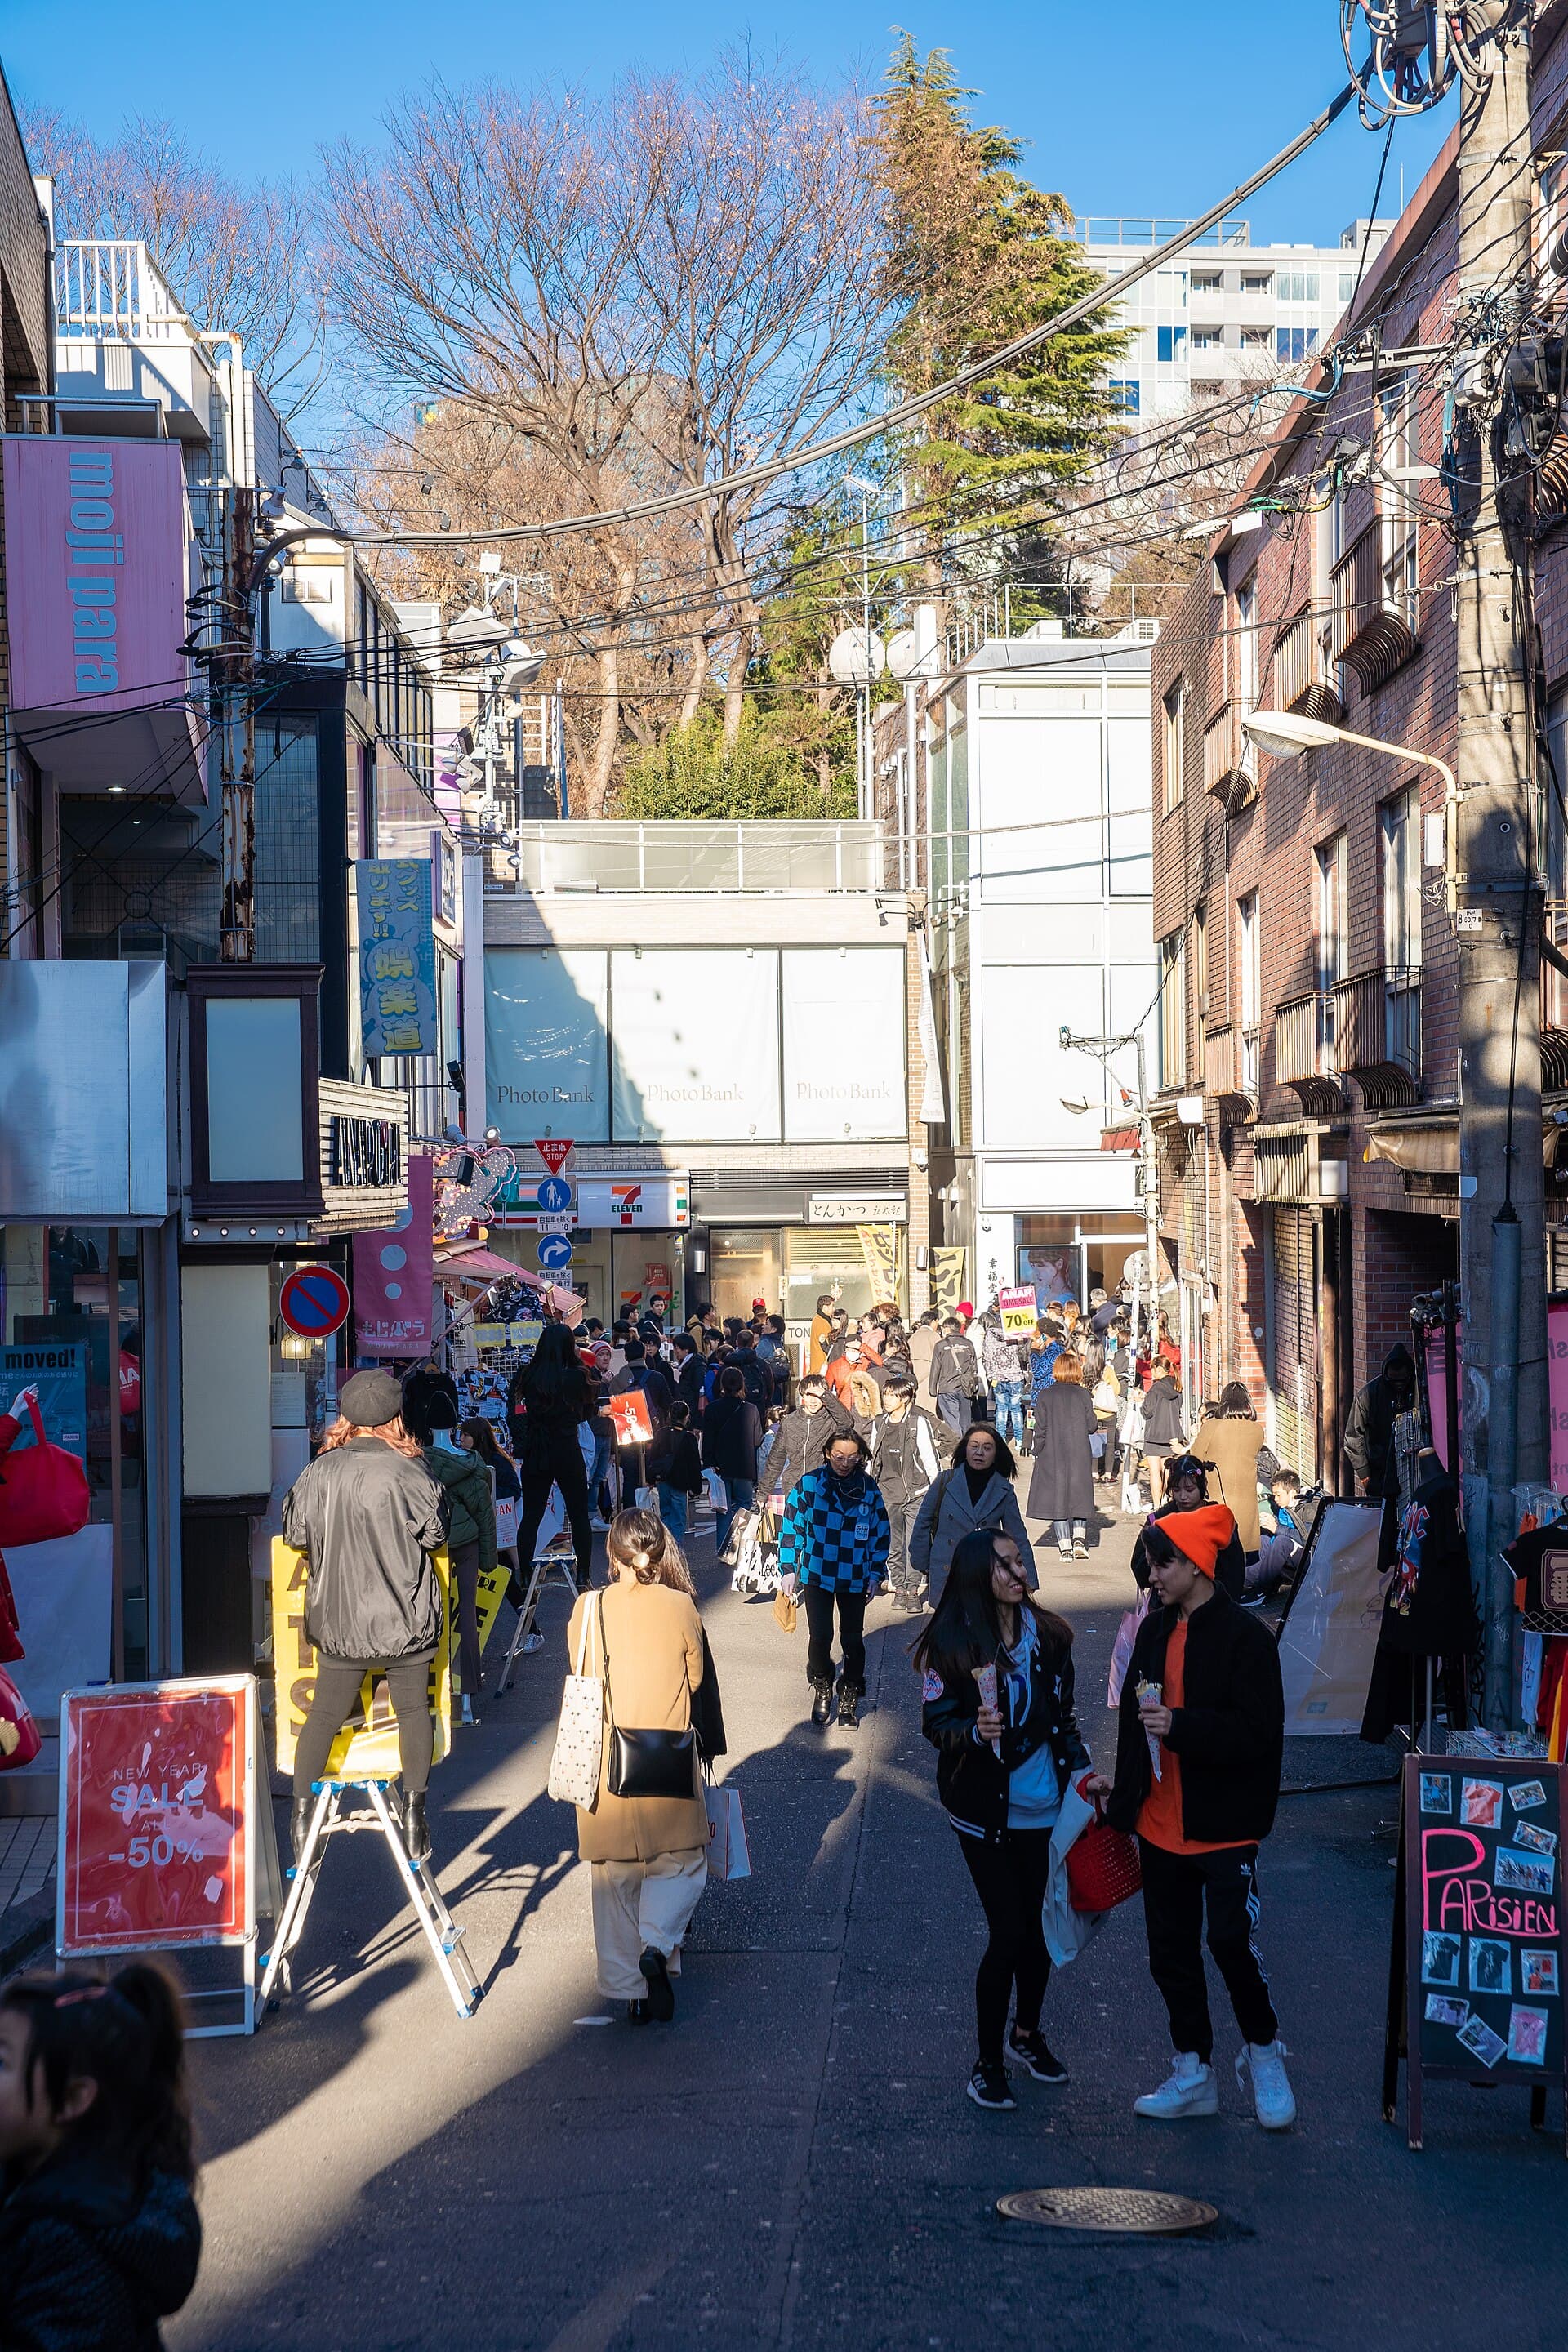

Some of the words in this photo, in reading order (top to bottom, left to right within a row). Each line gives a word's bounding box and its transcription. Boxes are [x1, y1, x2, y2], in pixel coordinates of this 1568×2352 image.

[66, 452, 124, 565] moji
[66, 577, 120, 693] para
[375, 947, 423, 1052] 娯楽道
[542, 1143, 567, 1152] 止まれ
[813, 1205, 866, 1218] とんかつ
[988, 1258, 997, 1294] 幸福堂
[1018, 1297, 1033, 1305] SALE
[5, 1349, 75, 1369] moved!
[113, 1767, 149, 1780] NEW
[158, 1762, 202, 1777] YEAR
[110, 1780, 203, 1813] SALE
[141, 1820, 171, 1832] ALL
[109, 1834, 203, 1868] -50%
